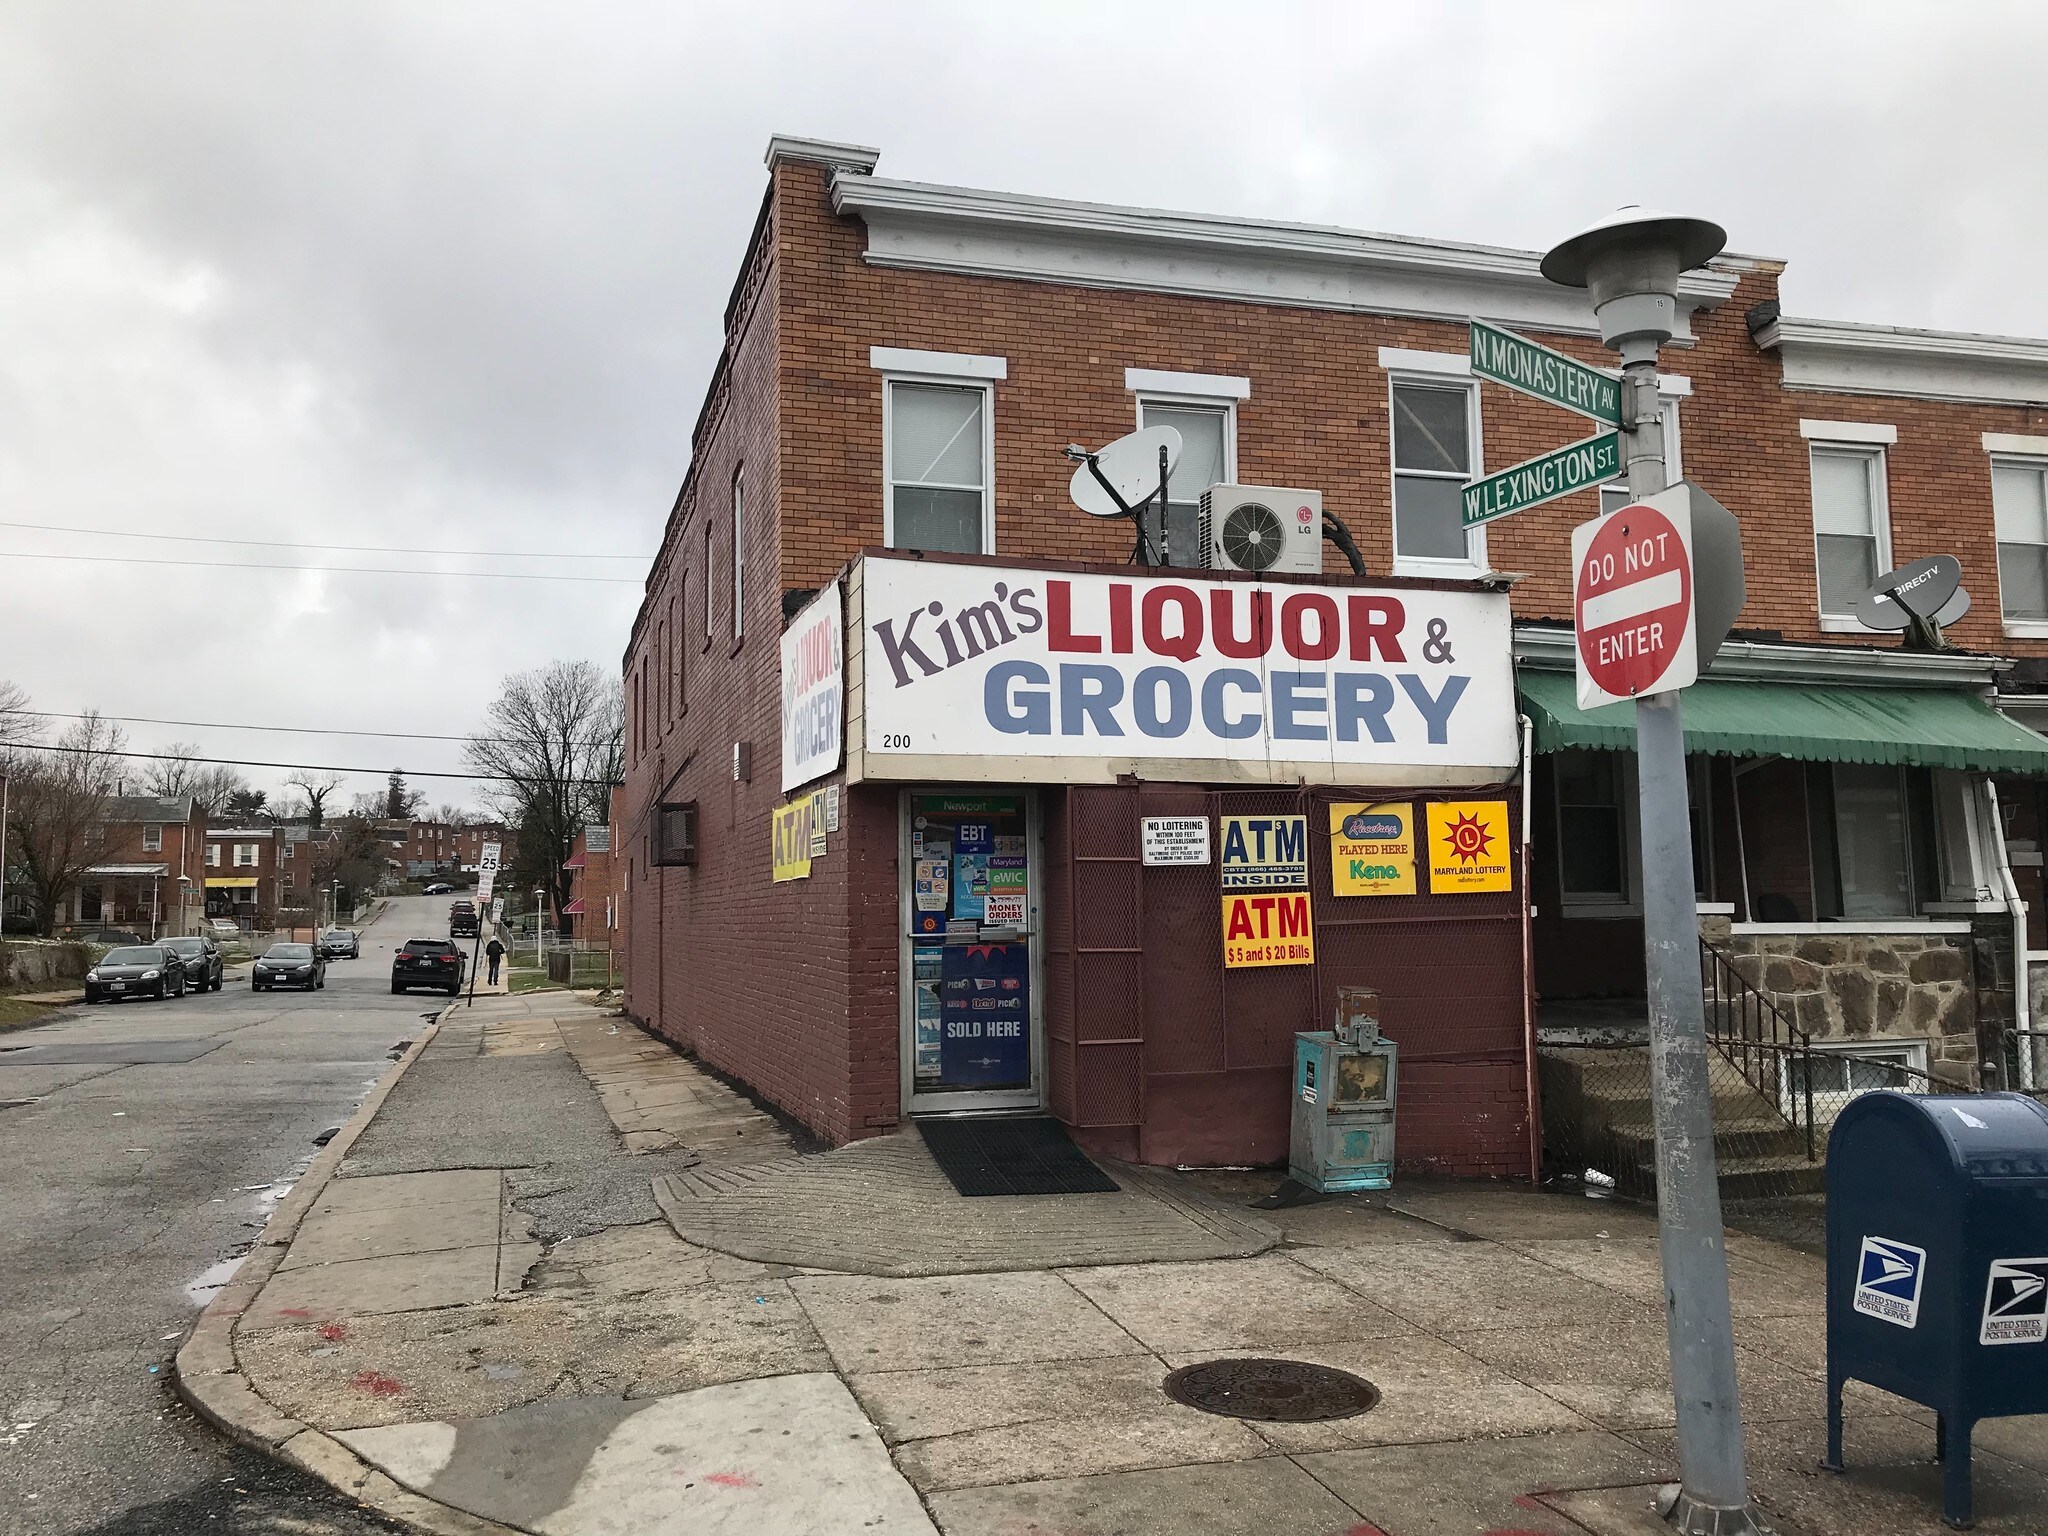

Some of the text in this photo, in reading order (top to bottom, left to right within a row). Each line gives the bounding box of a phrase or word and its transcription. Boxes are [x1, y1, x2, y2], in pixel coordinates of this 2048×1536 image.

[1298, 526, 1311, 535] LG
[1589, 532, 1668, 587] DO NOT
[873, 579, 1457, 690] Kim's LIQUOR &
[1598, 621, 1664, 667] ENTER
[796, 614, 833, 699] LIQUOR
[982, 659, 1472, 746] GROCERY
[882, 733, 911, 749] 200
[943, 800, 987, 812] Newport
[960, 825, 987, 841] EBT
[1148, 821, 1203, 831] NO LOITERING
[773, 804, 811, 868] ATM
[1222, 819, 1305, 864] ATM
[1338, 844, 1408, 856] PLAYED HERE
[481, 858, 497, 870] 25
[992, 858, 1023, 867] Maryland
[993, 872, 1023, 883] eWIC
[1434, 866, 1507, 876] MARYLAND LOTTERY
[1223, 874, 1305, 885] INSIDE
[1227, 896, 1309, 941] ATM
[1228, 944, 1310, 964] $ 5 and $ 20 Bills
[947, 1021, 1021, 1038] SOLD HERE
[1858, 1290, 1910, 1312] UNITED STATES
[1857, 1299, 1912, 1323] POSTAL SERVICE
[1986, 1320, 2041, 1330] UNITED STATES
[1985, 1330, 2043, 1340] POSTAL SERVICE
